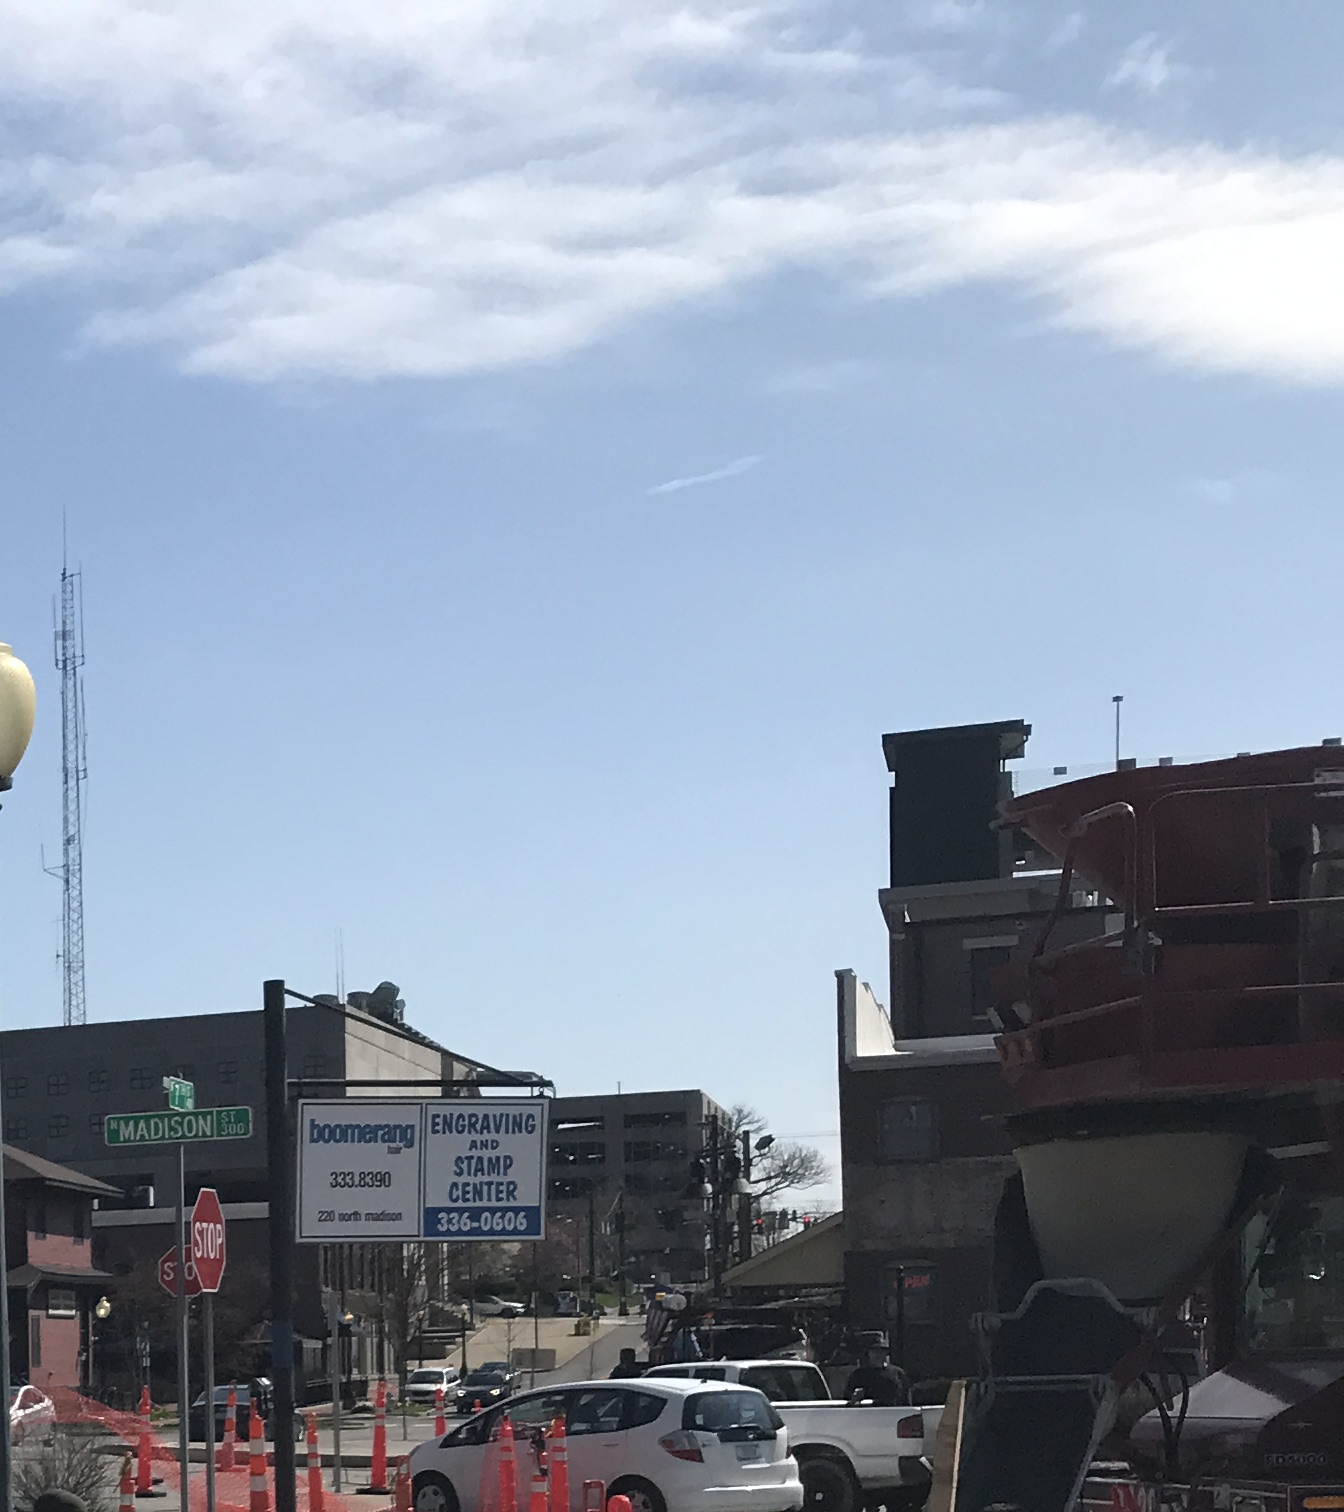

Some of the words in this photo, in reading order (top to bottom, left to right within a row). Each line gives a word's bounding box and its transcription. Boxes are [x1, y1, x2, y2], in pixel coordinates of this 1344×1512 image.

[221, 1111, 236, 1123] ST
[430, 1112, 537, 1135] ENGRAVING
[119, 1115, 212, 1142] MADISON
[221, 1122, 245, 1136] 300
[309, 1118, 416, 1149] boomerang
[468, 1139, 500, 1151] AND
[453, 1155, 514, 1178] STAMP
[330, 1171, 392, 1188] 333.8390
[448, 1181, 518, 1204] CENTER
[318, 1210, 336, 1222] 220
[338, 1210, 362, 1222] north
[364, 1210, 403, 1222] madison
[437, 1211, 528, 1232] 336-0606
[194, 1221, 223, 1259] STOP
[163, 1261, 197, 1281] SO
